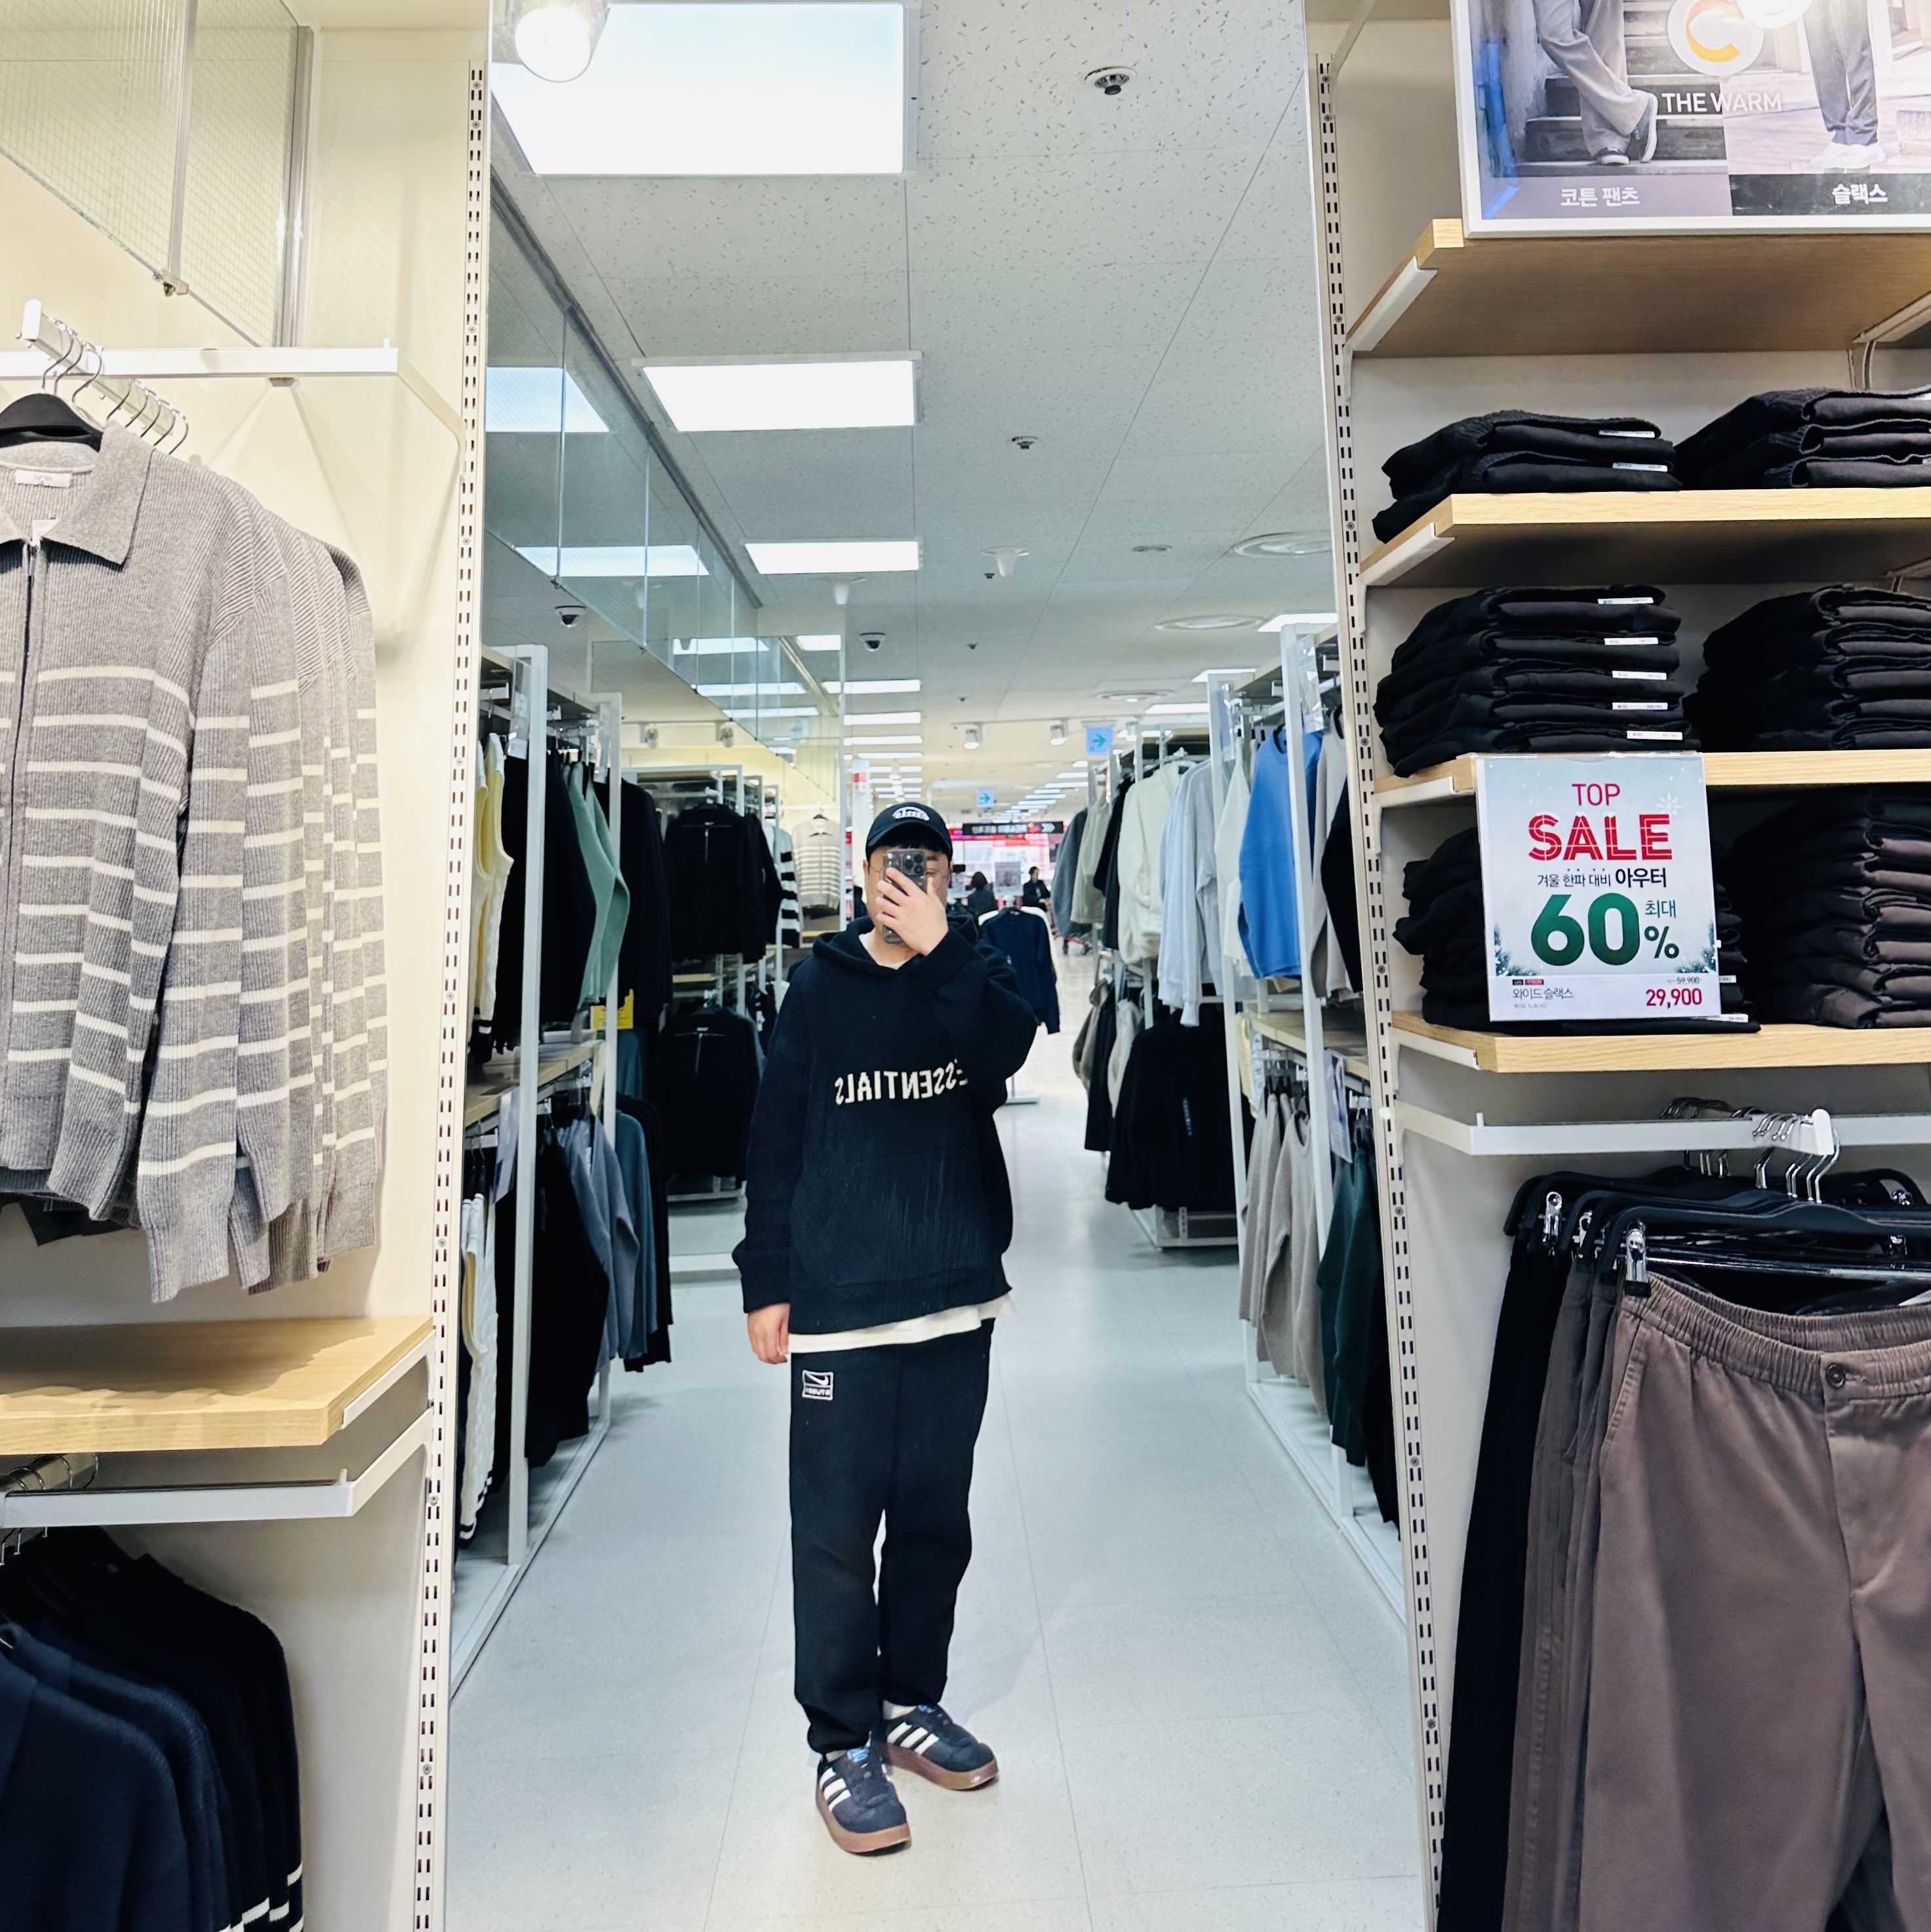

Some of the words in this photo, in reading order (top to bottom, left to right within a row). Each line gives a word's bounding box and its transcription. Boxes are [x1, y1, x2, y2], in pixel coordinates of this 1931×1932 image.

[1662, 93, 1707, 113] THE
[1711, 92, 1782, 112] WARM
[1561, 188, 1599, 207] 코튼
[1603, 188, 1641, 206] 팬츠
[1832, 184, 1888, 205] 슬랙스
[1572, 784, 1620, 806] TOP
[1528, 814, 1672, 860] SALE
[1538, 874, 1559, 887] 겨울
[1563, 874, 1586, 887] 한파
[1589, 874, 1611, 887] 대비
[1616, 868, 1667, 888] 아우터
[1645, 900, 1677, 918] 최대
[1531, 893, 1679, 966] 60%
[1677, 976, 1700, 985] 59,900
[1646, 988, 1703, 1009] 29,900
